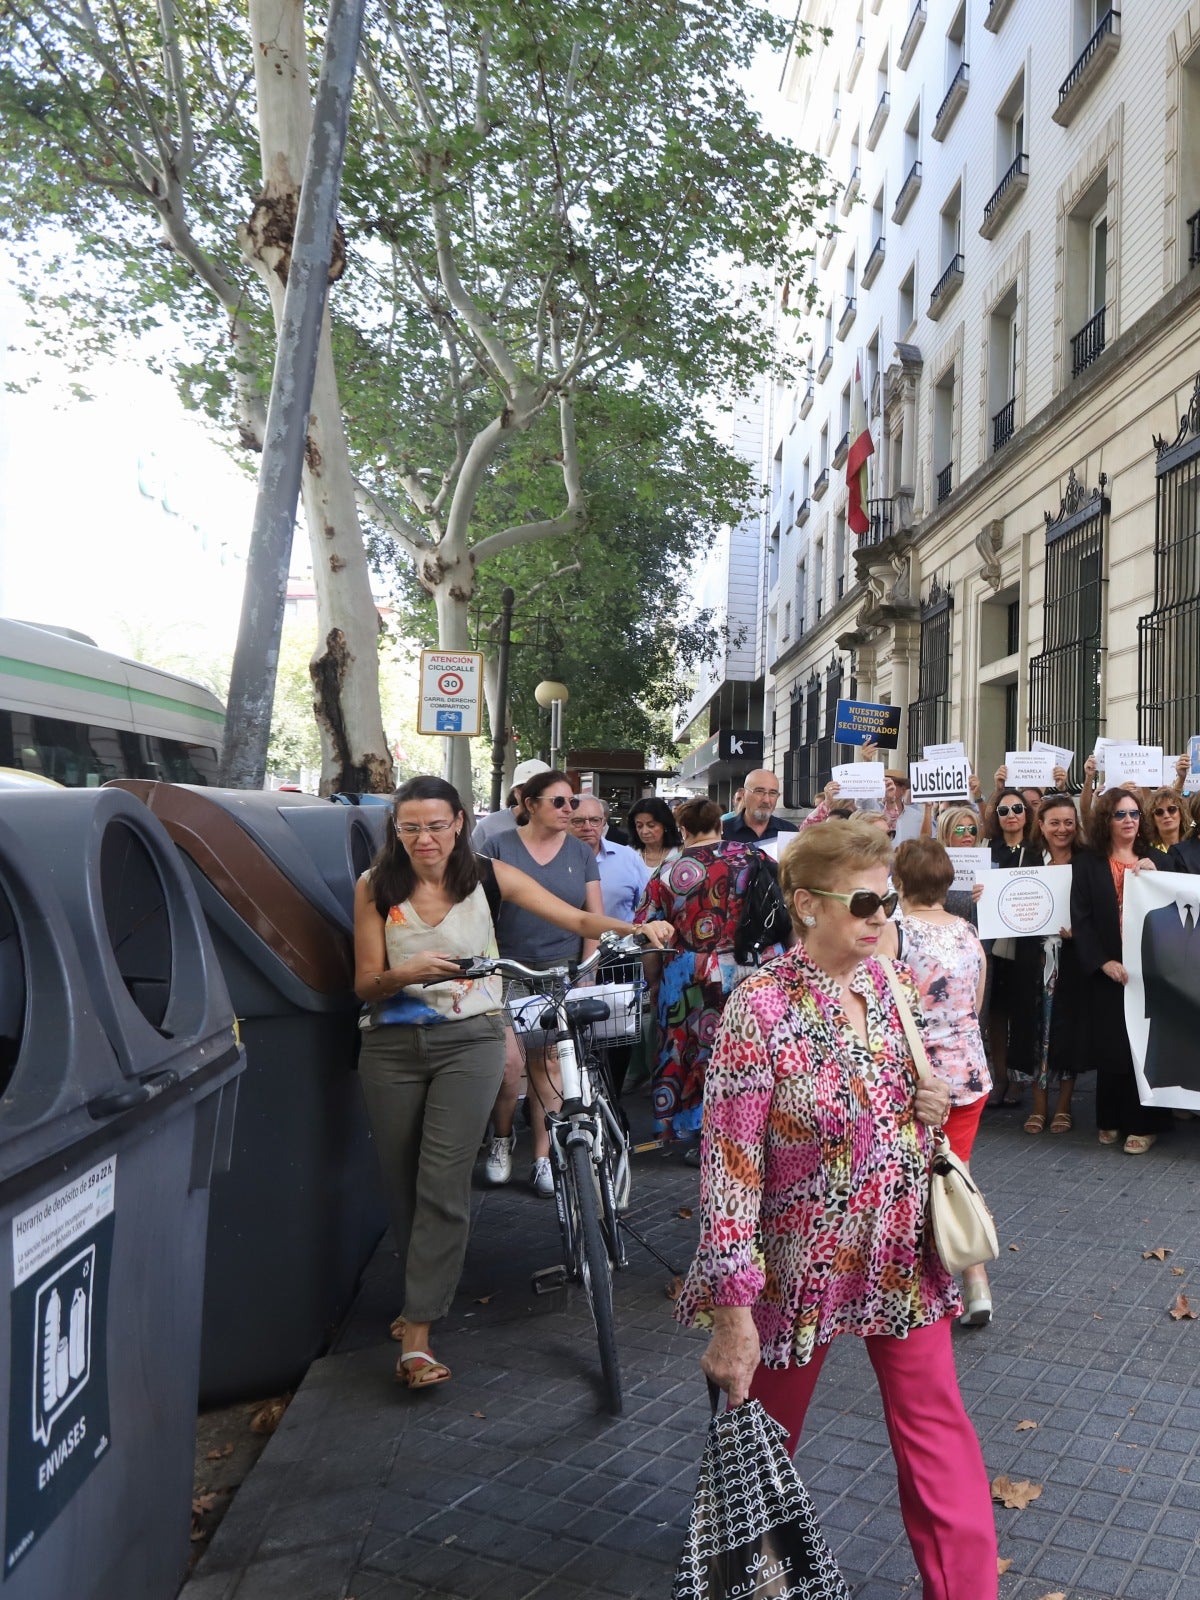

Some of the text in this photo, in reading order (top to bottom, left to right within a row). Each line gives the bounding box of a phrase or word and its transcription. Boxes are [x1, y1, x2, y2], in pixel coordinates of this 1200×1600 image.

[430, 655, 473, 664] ATENCIÓN
[428, 664, 475, 673] CICLOCALLE
[443, 679, 458, 688] 30
[848, 706, 890, 719] NUESTROS
[852, 715, 885, 726] FONDOS
[837, 721, 898, 735] SECUESTRADOS
[912, 764, 968, 792] Justicia!
[1009, 869, 1039, 877] CÓRDOBA
[16, 1211, 43, 1238] Horario
[43, 1203, 53, 1219] de
[52, 1187, 79, 1214] depósito
[79, 1180, 88, 1194] de
[87, 1174, 96, 1189] 19
[95, 1173, 100, 1183] a
[100, 1166, 108, 1180] 22
[38, 1415, 87, 1491] ENVASES
[725, 1556, 793, 1599] LOLA RUIZ
